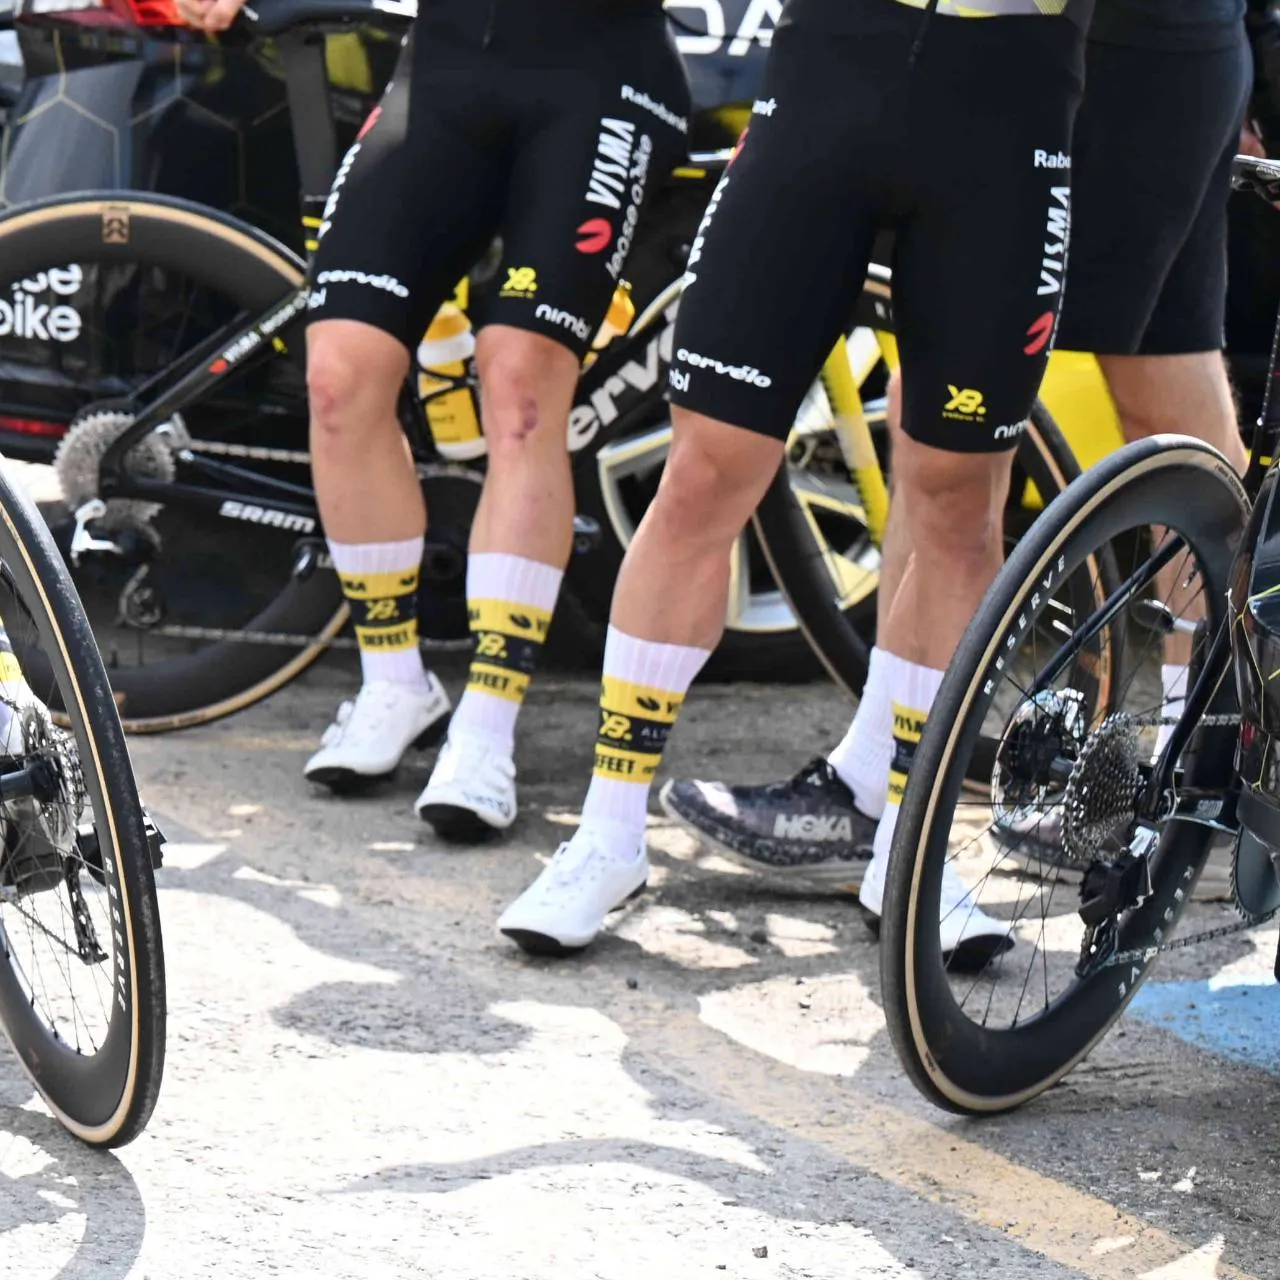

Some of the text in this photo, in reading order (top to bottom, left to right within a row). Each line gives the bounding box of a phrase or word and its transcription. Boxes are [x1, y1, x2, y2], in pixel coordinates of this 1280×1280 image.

[585, 117, 636, 210] VISMA
[1036, 186, 1071, 296] VISMA
[535, 303, 592, 341] nimbl
[676, 347, 772, 389] cervélo
[218, 500, 315, 534] SRAM
[983, 553, 1065, 696] RESERVE
[595, 754, 637, 775] EFEET
[773, 814, 853, 842] HOKA
[104, 855, 127, 1013] RESERVE
[1118, 864, 1195, 998] RESEVE
